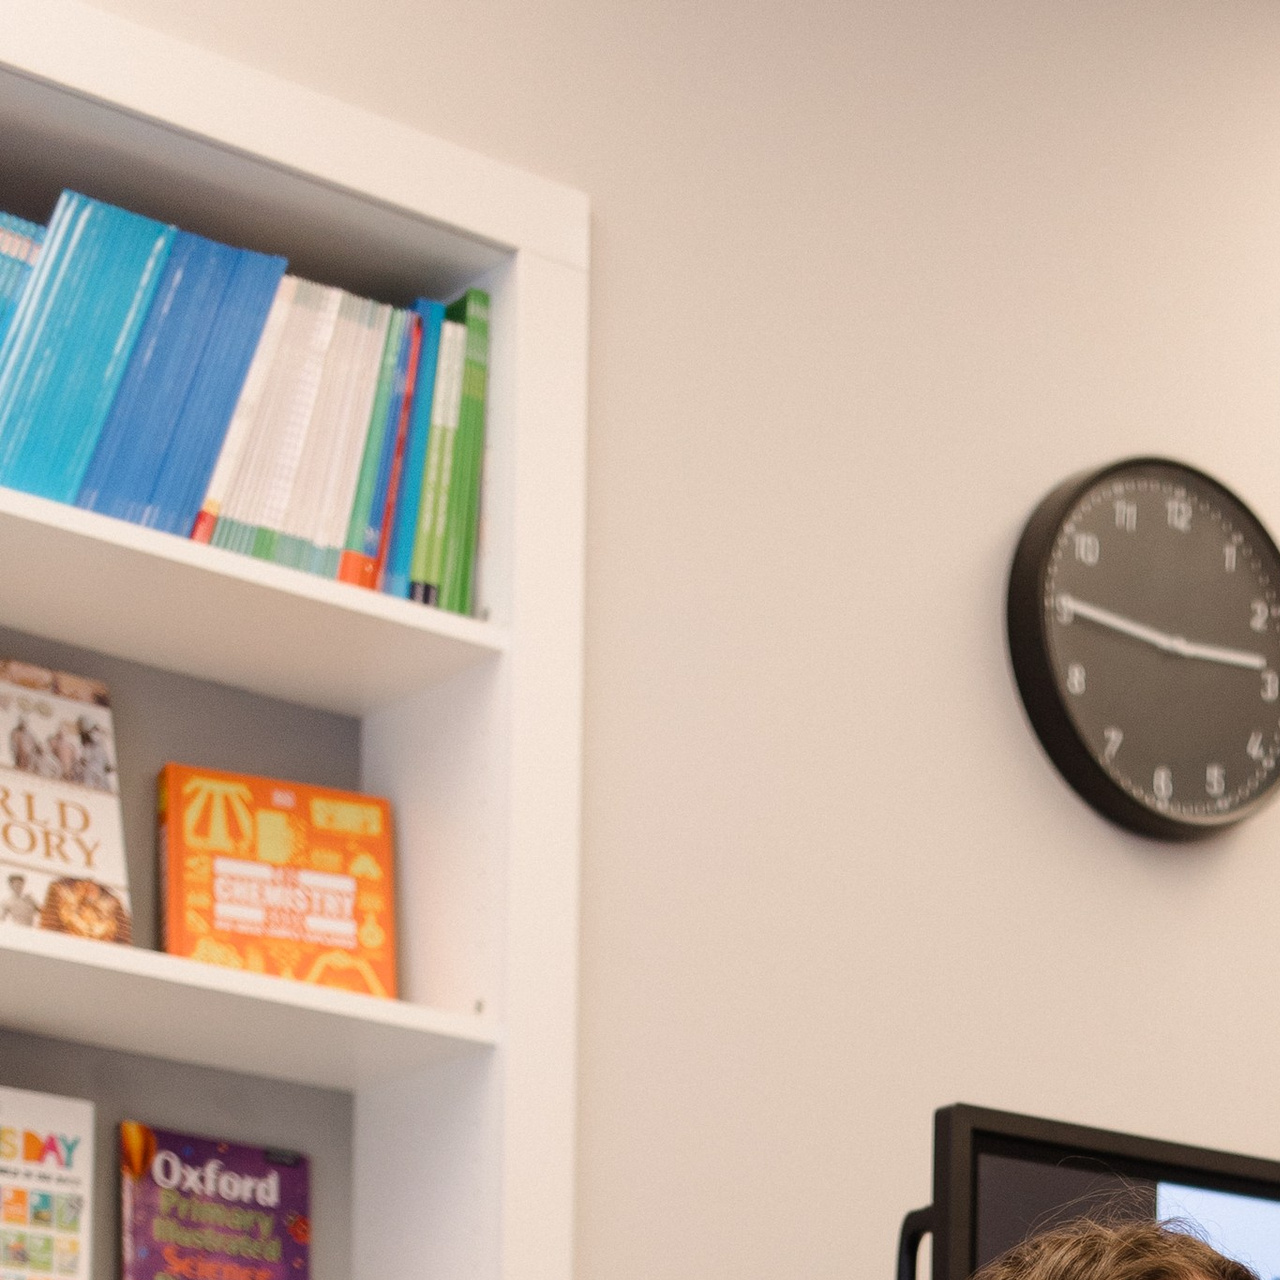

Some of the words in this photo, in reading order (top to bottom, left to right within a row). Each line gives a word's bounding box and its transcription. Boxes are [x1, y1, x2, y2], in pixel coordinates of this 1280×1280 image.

[1167, 500, 1192, 532] 12
[1075, 534, 1100, 566] 10
[1251, 600, 1268, 632] 2
[1067, 663, 1086, 695] 8
[1261, 670, 1279, 701] 3
[1104, 727, 1123, 762] 7
[1247, 731, 1265, 760] 4
[1154, 765, 1173, 801] 6
[1206, 763, 1226, 797] 5
[23, 1129, 80, 1169] DAY
[152, 1150, 281, 1208] Oxford
[160, 1189, 274, 1241] Primary
